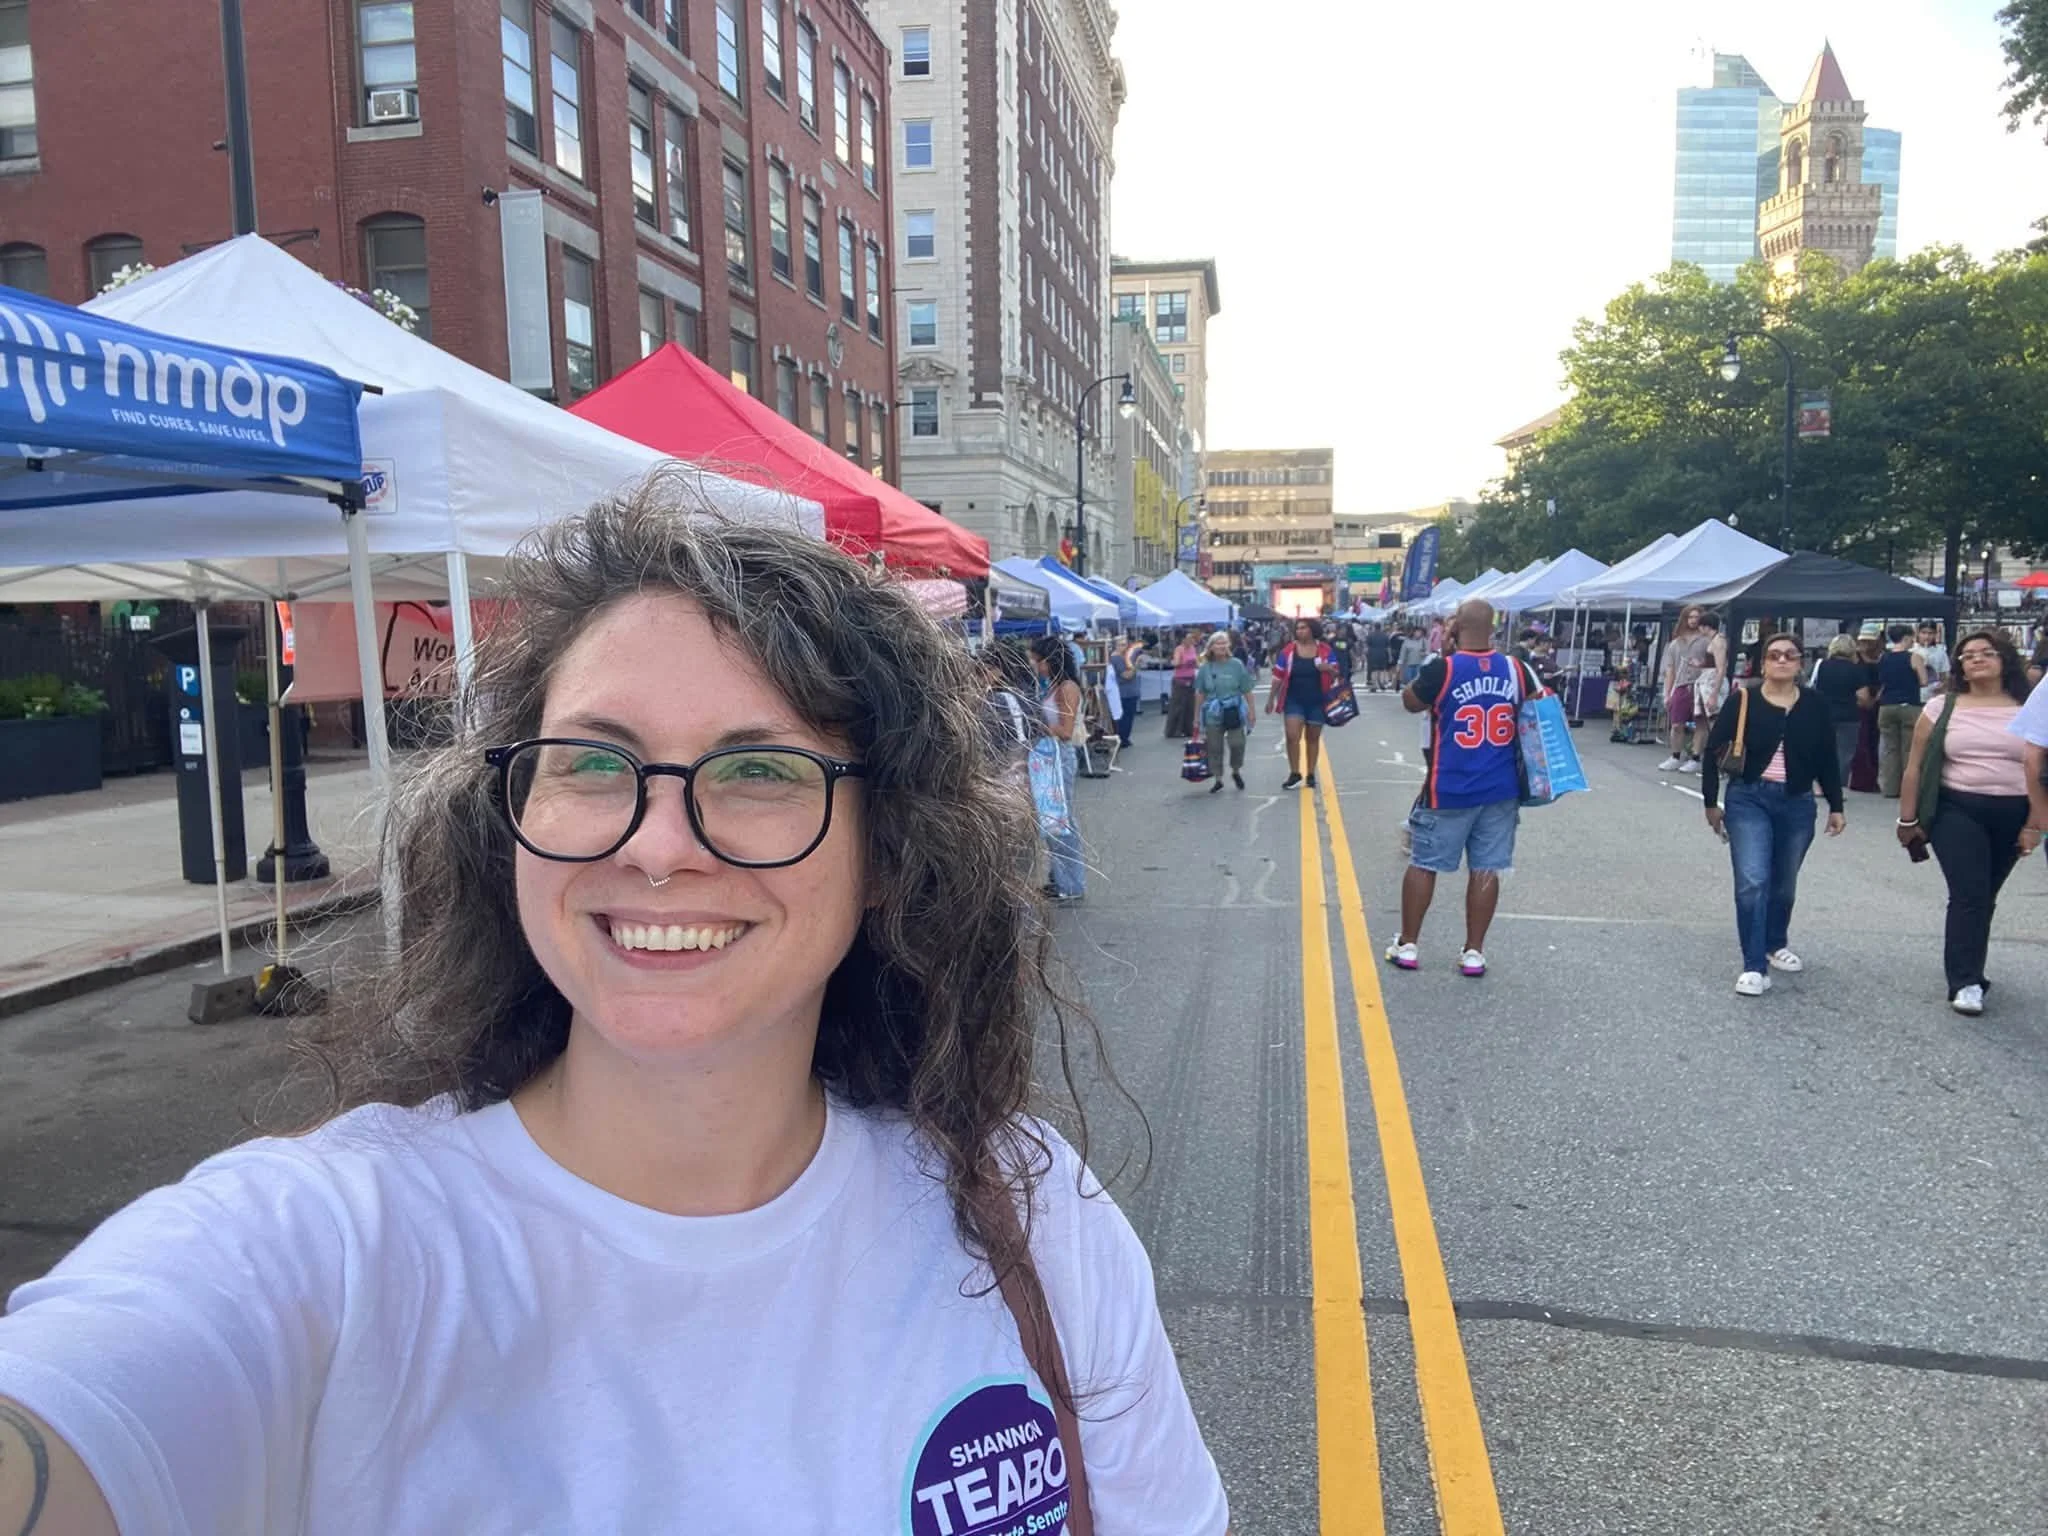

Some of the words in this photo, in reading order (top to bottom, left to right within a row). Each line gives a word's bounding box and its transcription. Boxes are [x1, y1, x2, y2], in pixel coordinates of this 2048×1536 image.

[111, 408, 146, 425] FIND
[150, 414, 198, 433] CURES.
[199, 421, 233, 438] SAVE
[233, 427, 270, 444] LIVES.
[181, 666, 196, 691] P
[1453, 703, 1516, 749] 36
[949, 1419, 1043, 1468] SHANNON
